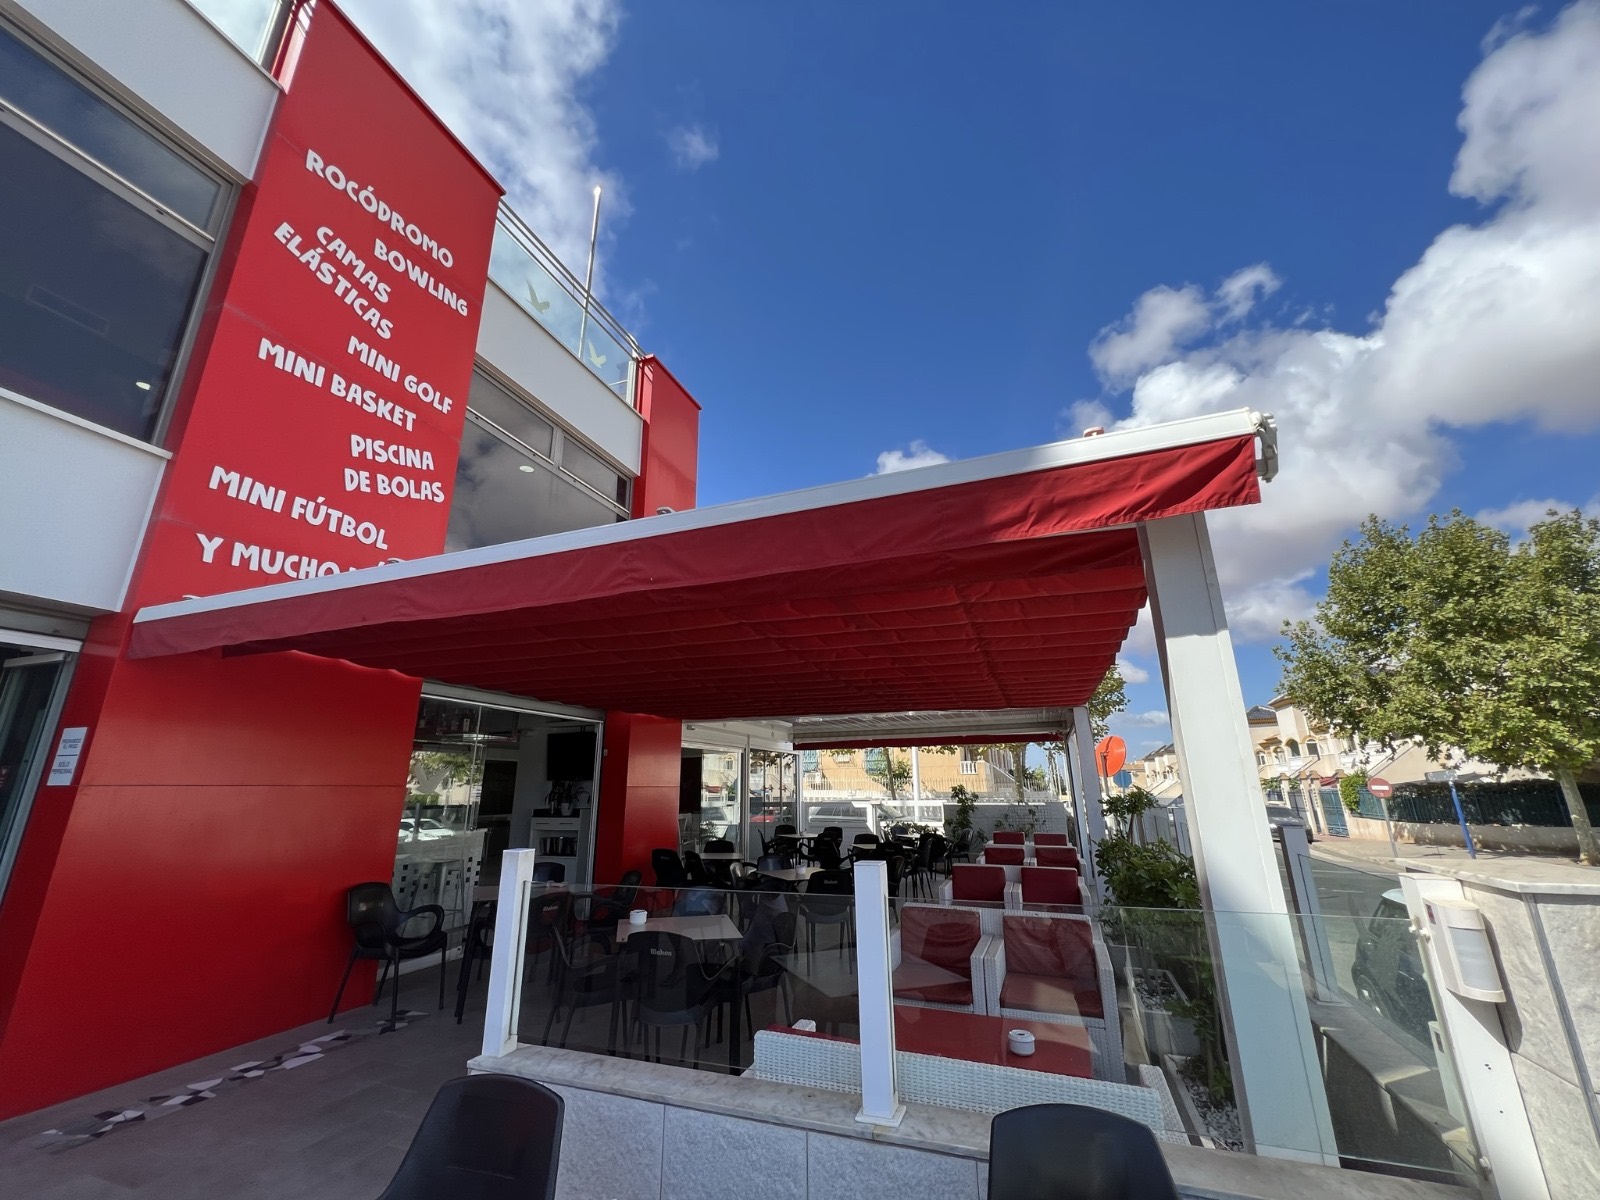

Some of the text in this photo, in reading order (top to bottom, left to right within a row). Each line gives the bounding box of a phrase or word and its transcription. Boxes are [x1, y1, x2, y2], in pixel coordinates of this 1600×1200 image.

[306, 149, 454, 268] ROCÓDROMO
[273, 221, 394, 340] ELÁSTICAS
[316, 226, 392, 303] CAMAS
[374, 238, 468, 317] BOWLING
[258, 337, 417, 432] MINI BASKET
[347, 335, 453, 415] MINI GOLF
[344, 468, 445, 503] DE BOLAS
[350, 434, 435, 471] PISCINA
[208, 465, 389, 551] MINI FÚTBOL
[196, 532, 341, 580] Y MUCHO
